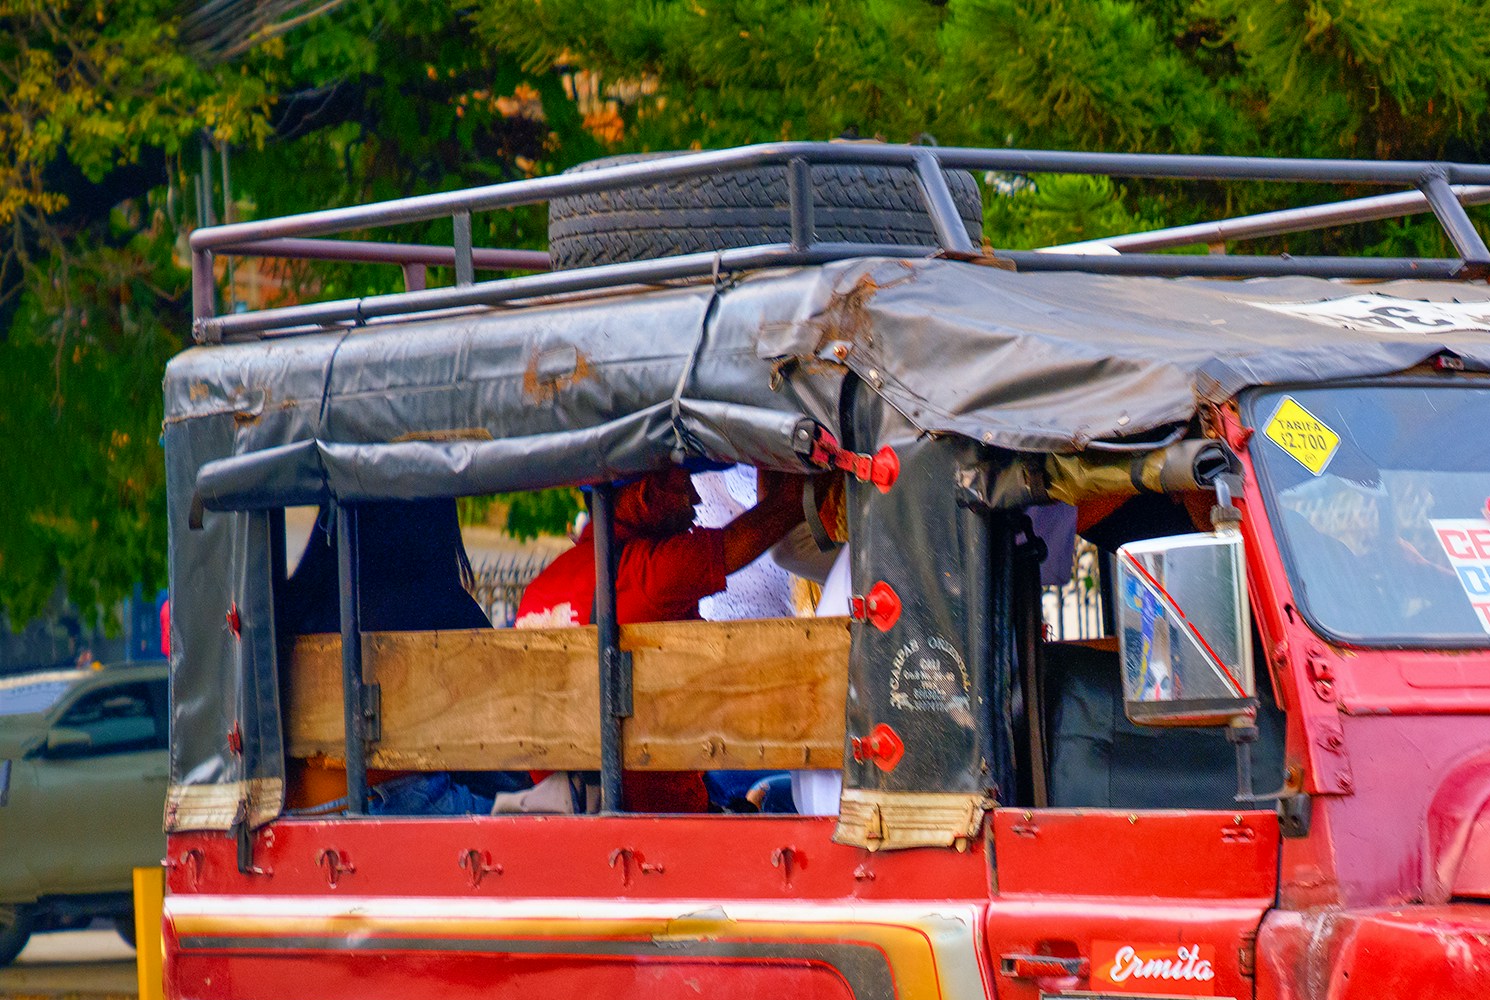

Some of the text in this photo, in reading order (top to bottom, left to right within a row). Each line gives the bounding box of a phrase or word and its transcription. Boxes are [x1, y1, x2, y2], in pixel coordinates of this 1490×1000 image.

[1275, 417, 1323, 432] TARIFA
[1281, 432, 1327, 451] $2.700
[1110, 944, 1215, 982] Ermita
